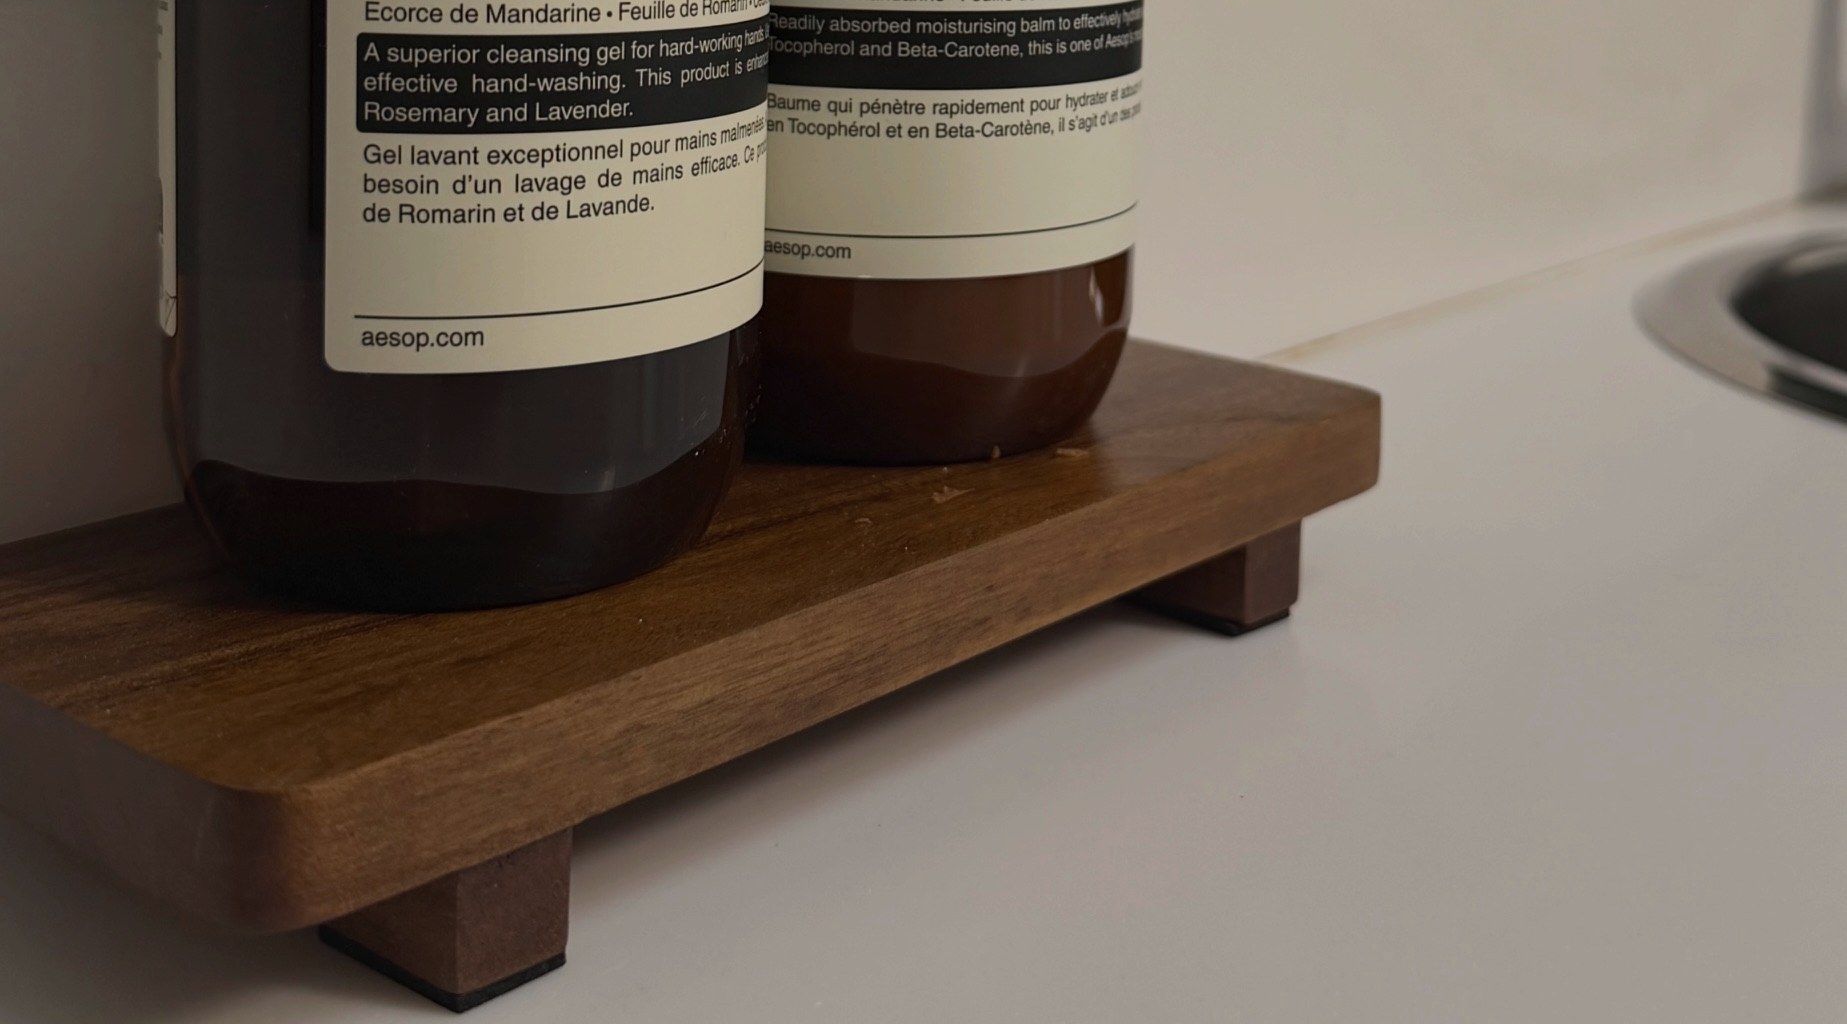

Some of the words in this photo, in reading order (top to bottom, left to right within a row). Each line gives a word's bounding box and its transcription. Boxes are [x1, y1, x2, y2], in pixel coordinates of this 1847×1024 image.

[365, 1, 442, 22] Ecorce
[450, 4, 478, 22] de
[486, 2, 600, 24] Mandarine
[618, 1, 674, 19] Feuille
[829, 14, 911, 34] absorbed
[916, 14, 1016, 37] moisturising
[1021, 12, 1054, 32] balm
[1058, 15, 1071, 31] to
[363, 43, 380, 62] A
[387, 45, 479, 67] superior
[486, 44, 590, 66] cleansing
[597, 42, 625, 66] gel
[631, 42, 654, 59] for
[659, 32, 742, 57] hard-working
[860, 39, 892, 56] and
[897, 41, 1024, 59] Beta-Carotene,
[1028, 39, 1052, 56] this
[1057, 39, 1066, 54] is
[1070, 40, 1092, 52] one
[1094, 34, 1103, 50] of
[363, 74, 458, 93] effective
[472, 72, 625, 95] hand-washing.
[636, 67, 671, 87] This
[680, 60, 730, 88] product
[734, 57, 743, 75] is
[363, 102, 479, 127] Rosemary
[486, 103, 527, 122] and
[535, 100, 633, 121] Lavender.
[767, 93, 821, 112] Baume
[828, 96, 852, 115] qui
[860, 96, 926, 116] pénètre
[933, 98, 1025, 116] rapidement
[1030, 97, 1061, 115] pour
[1066, 91, 1108, 111] hydrater
[767, 117, 784, 133] en
[788, 118, 880, 140] Tocophérol
[886, 122, 904, 137] et
[908, 123, 929, 138] en
[935, 122, 1053, 139] Beta-Carotène,
[1058, 118, 1064, 132] il
[363, 144, 402, 165] Gel
[410, 144, 479, 165] lavant
[487, 140, 624, 168] exceptionnel
[630, 138, 670, 162] pour
[675, 130, 717, 153] mains
[363, 175, 439, 194] besoin
[514, 174, 586, 196] lavage
[597, 169, 622, 188] de
[632, 163, 684, 186] mains
[691, 154, 740, 177] efficace.
[363, 204, 390, 223] de
[398, 204, 495, 224] Romarin
[503, 205, 525, 222] et
[531, 201, 559, 220] de
[566, 196, 655, 219] Lavande.
[764, 241, 851, 259] aesop.com
[361, 329, 484, 352] aesop.com
